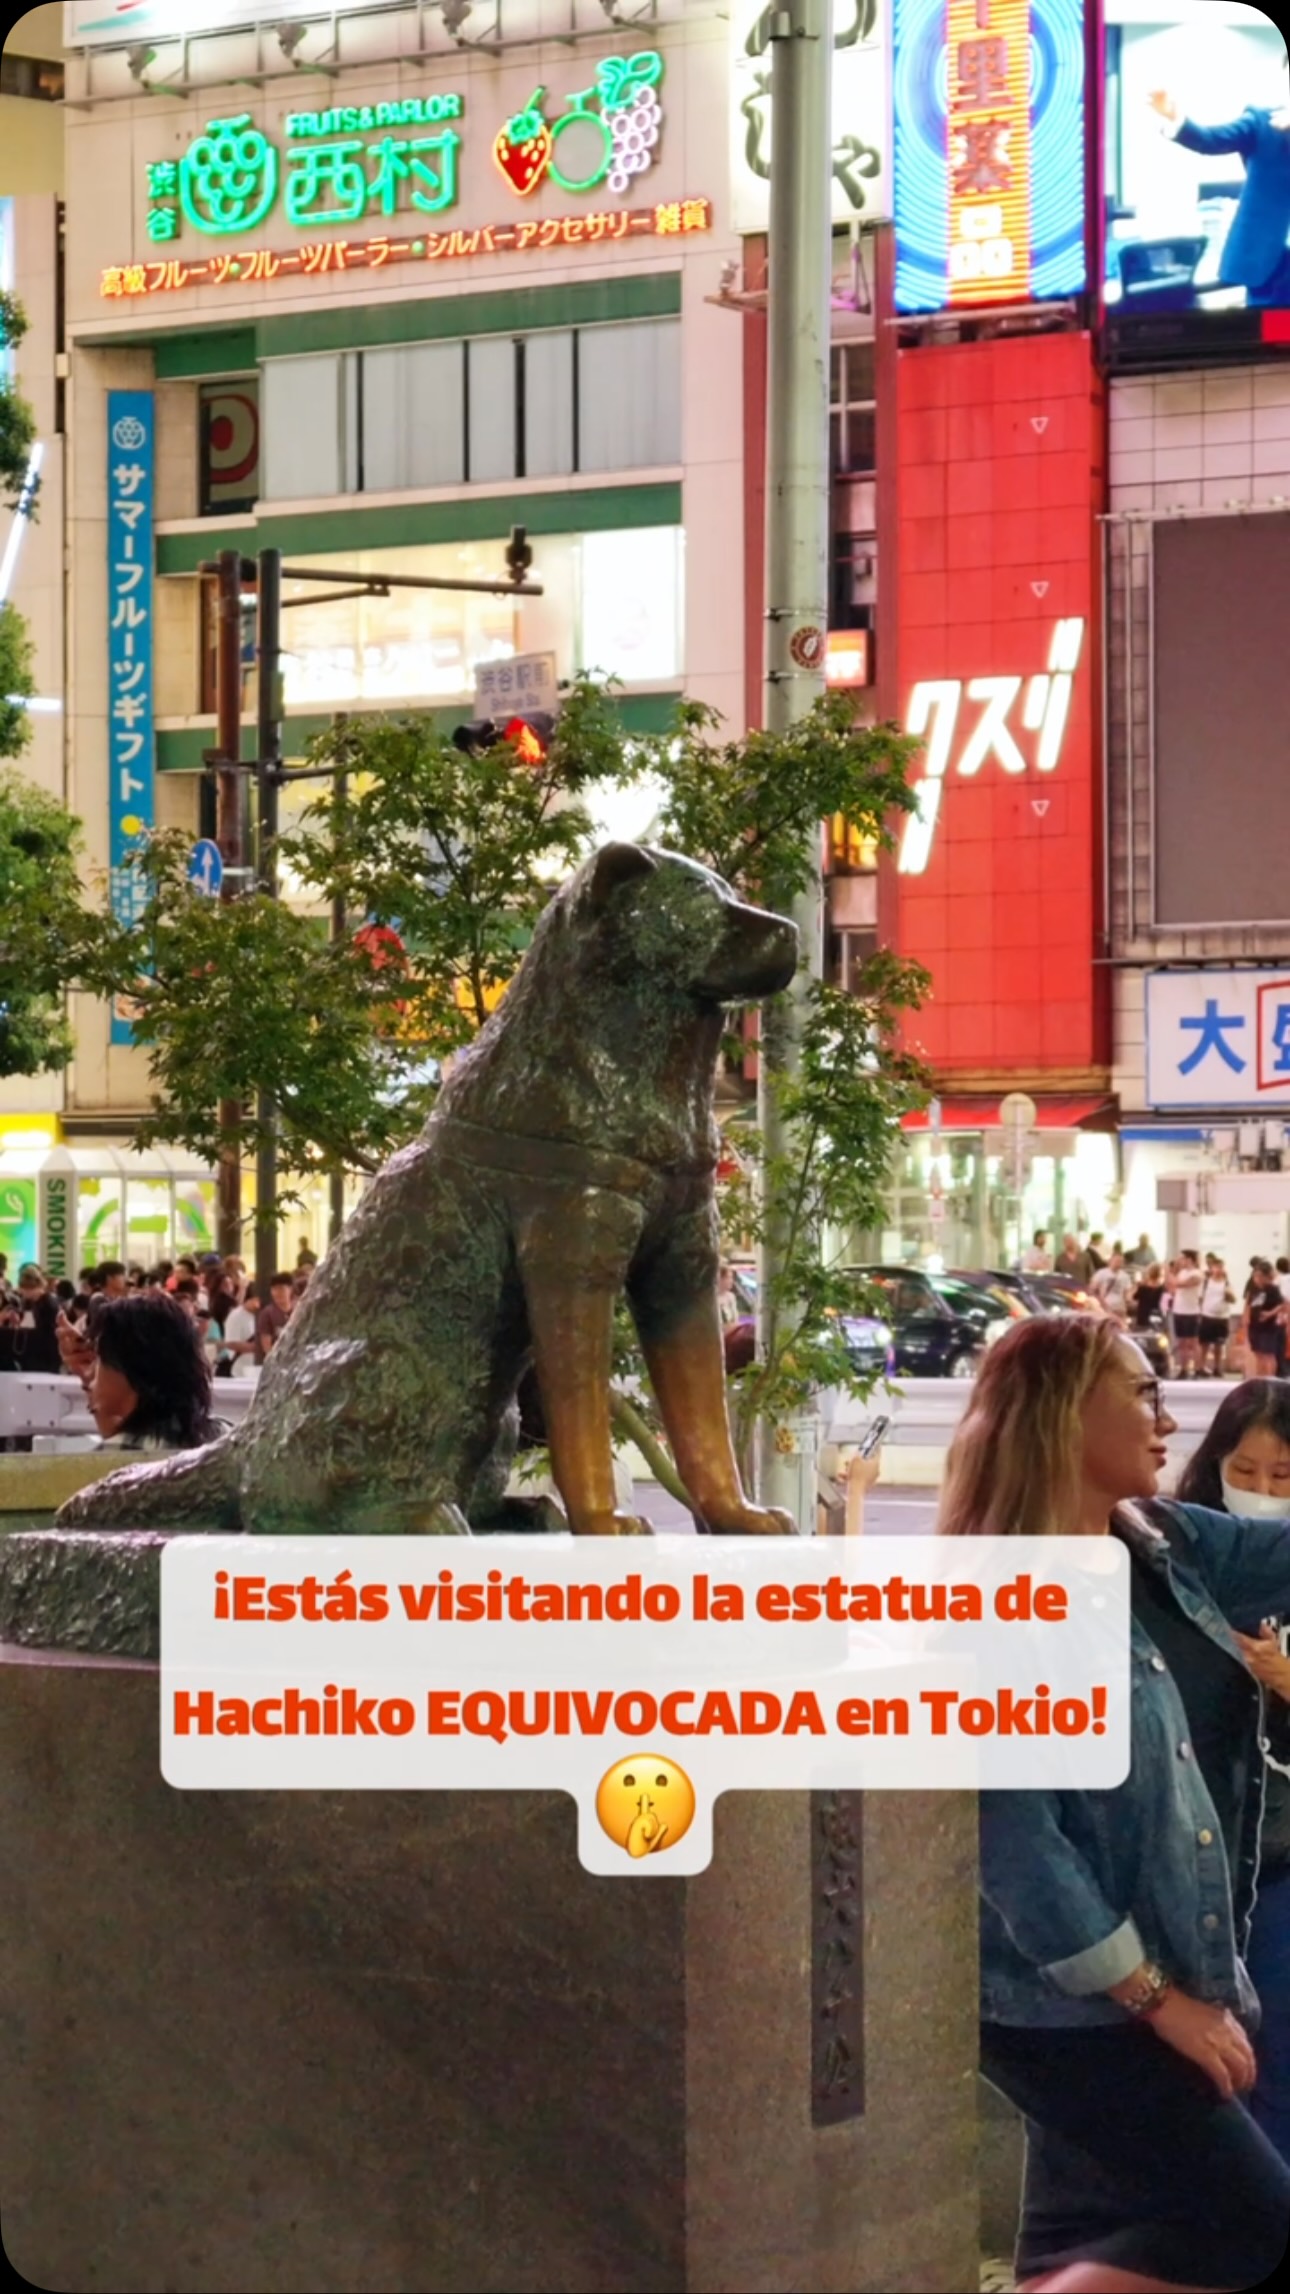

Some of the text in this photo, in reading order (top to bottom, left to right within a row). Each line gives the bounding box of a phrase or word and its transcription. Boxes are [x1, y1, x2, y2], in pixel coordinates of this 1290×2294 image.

[145, 159, 177, 241] 渋谷
[284, 128, 461, 226] 西村
[951, 0, 1015, 279] 里薬品
[111, 462, 147, 801] サマーフルーツギフト
[897, 616, 1085, 876] クスリ
[46, 1178, 66, 1278] SMOKIN
